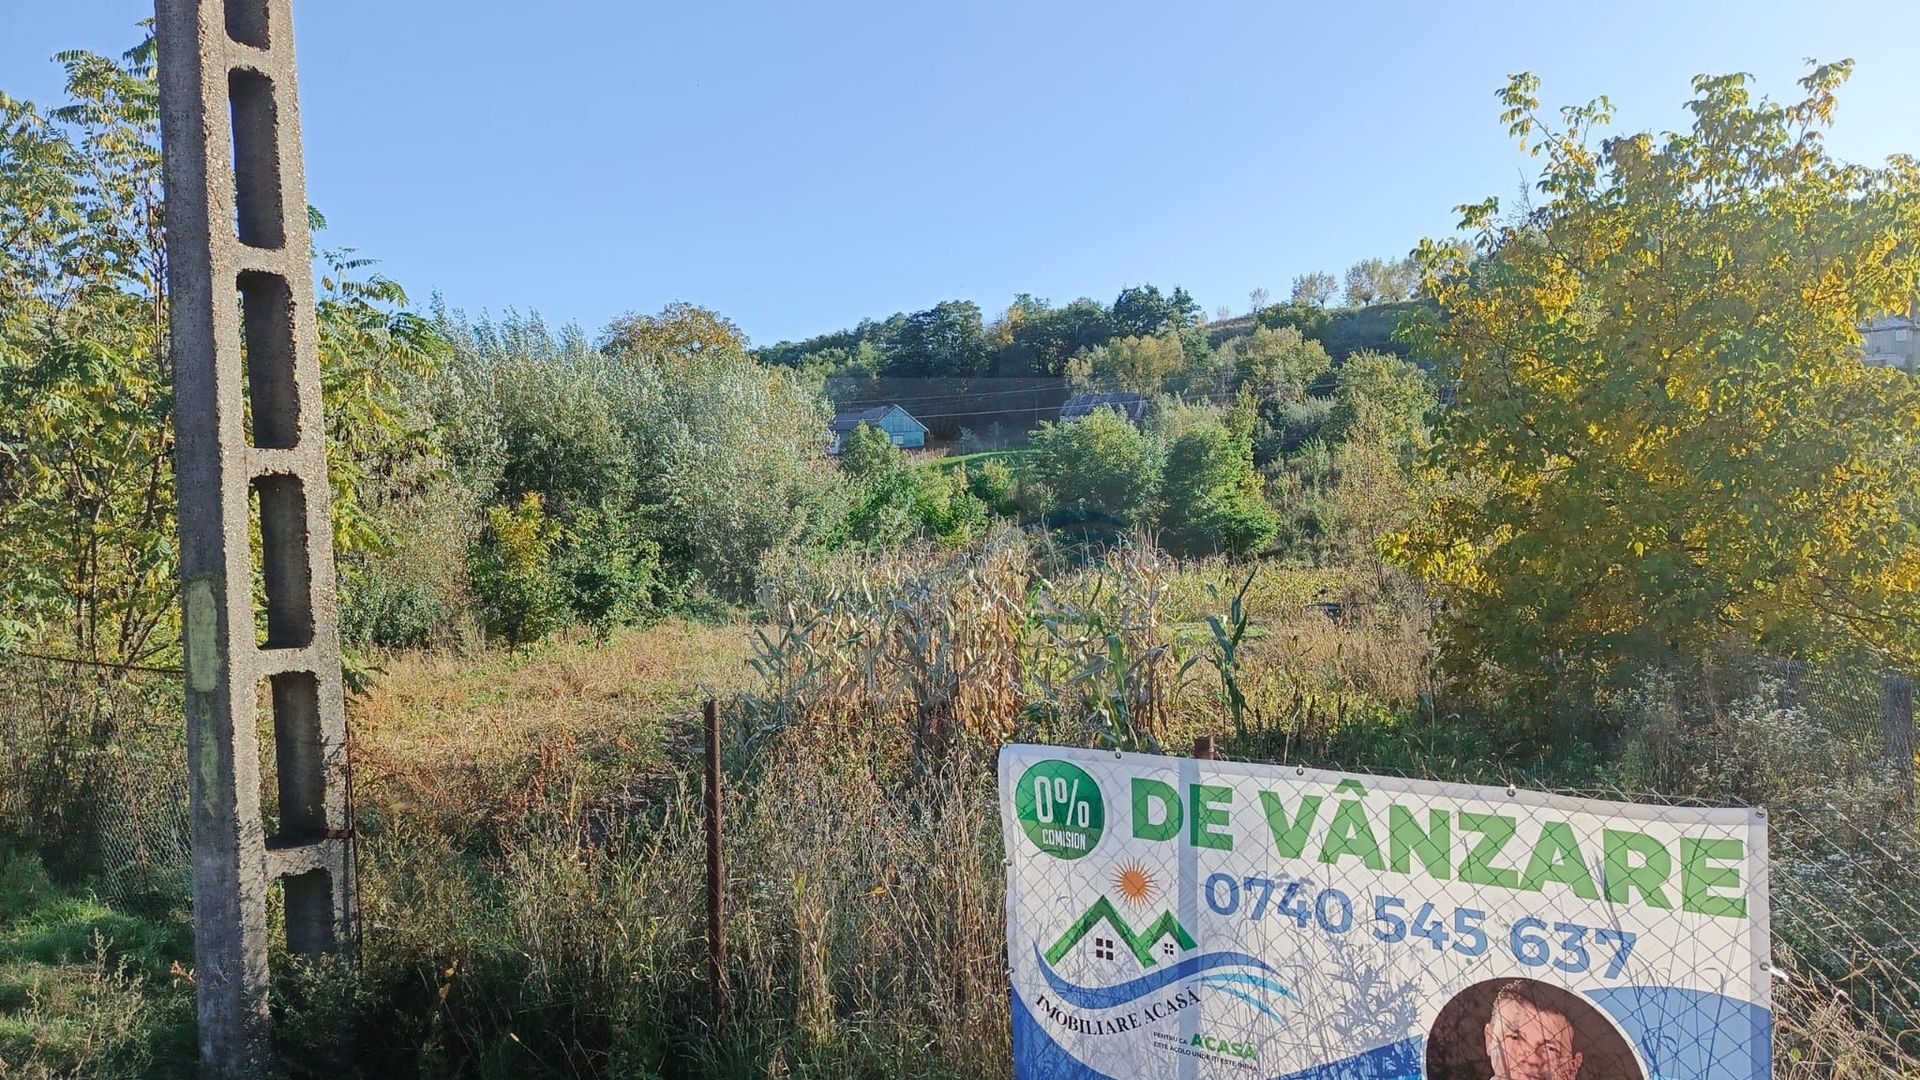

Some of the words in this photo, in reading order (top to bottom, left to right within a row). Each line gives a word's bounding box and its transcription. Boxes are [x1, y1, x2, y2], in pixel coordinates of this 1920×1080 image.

[1034, 775, 1090, 829] 0%
[1042, 828, 1087, 851] COMISION
[1130, 777, 1234, 852] DE
[1258, 778, 1748, 920] VÂNZARE
[1205, 873, 1354, 935] 0740
[1372, 896, 1488, 957] 545
[1509, 917, 1638, 980] 637
[1035, 994, 1142, 1036] IMOBILIARE
[1144, 986, 1201, 1025] ACASĂ
